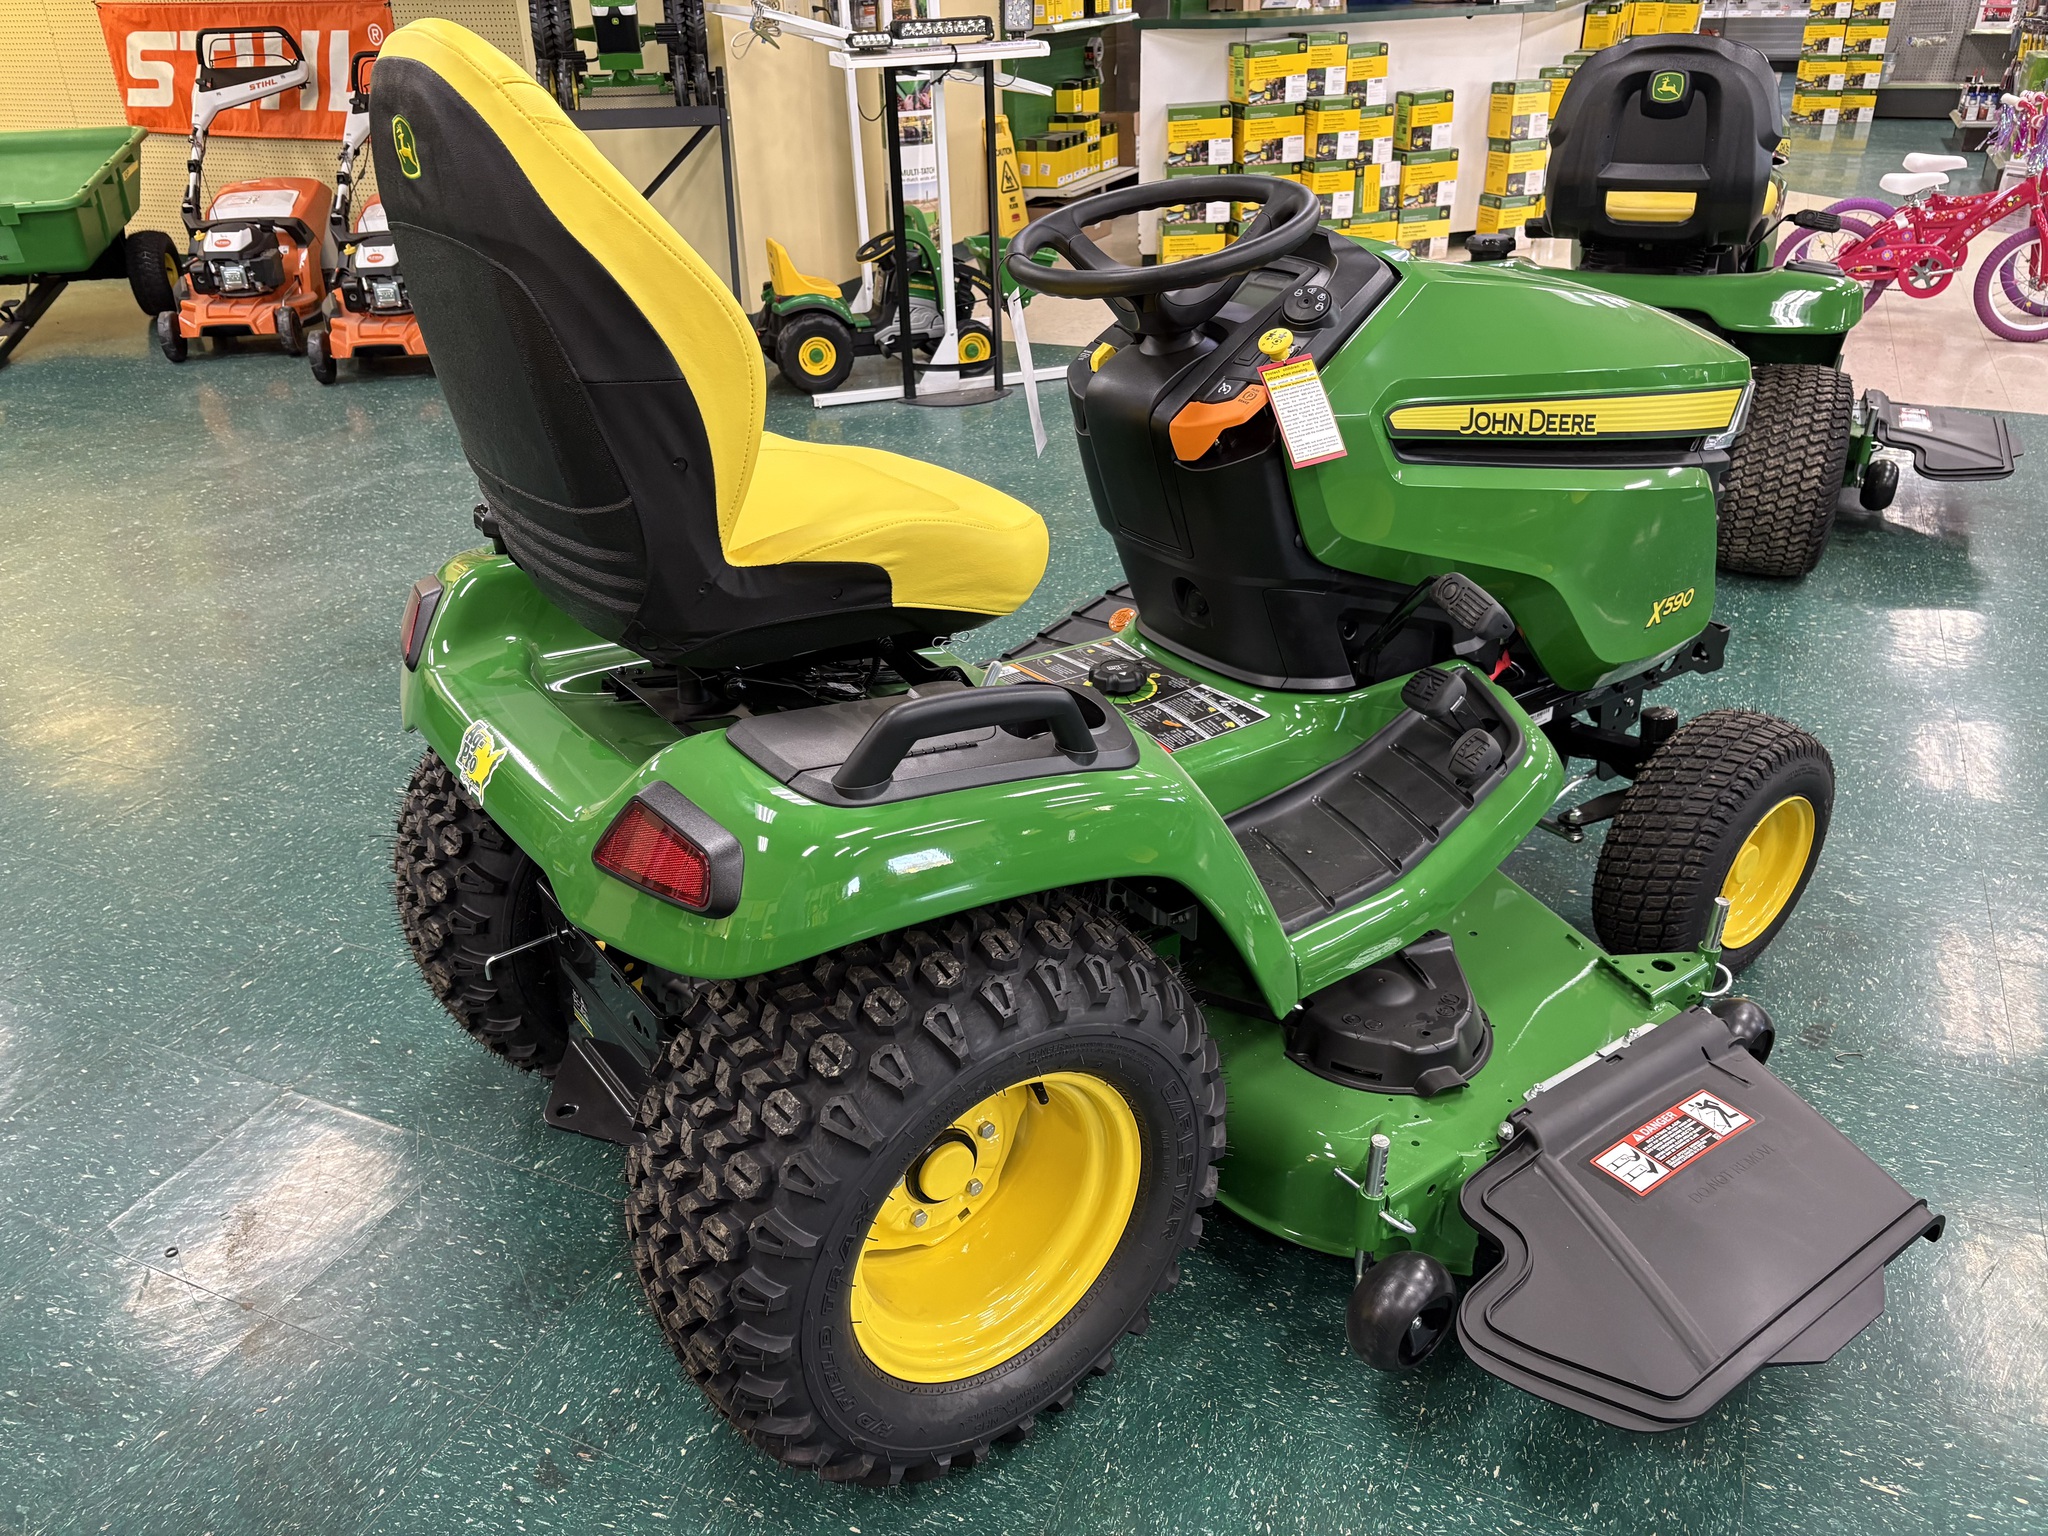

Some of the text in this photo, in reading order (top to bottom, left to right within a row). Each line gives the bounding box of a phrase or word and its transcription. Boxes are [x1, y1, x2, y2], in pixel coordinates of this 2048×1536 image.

[126, 30, 353, 111] STIHL
[249, 78, 278, 91] STIHL
[1460, 407, 1596, 433] JOHN DEERE
[1644, 586, 1696, 629] X590
[1640, 1111, 1678, 1136] DANGER
[1645, 1119, 1682, 1144] ROTATING BLADE
[1656, 1126, 1695, 1152] THROWN OBJECTS
[1161, 1079, 1194, 1240] CARLSTAR
[1688, 1187, 1711, 1204] DO
[1706, 1171, 1735, 1190] NOT
[1731, 1143, 1775, 1174] REMOVE
[822, 1201, 875, 1316] TRAX
[819, 1325, 858, 1412] FIELD
